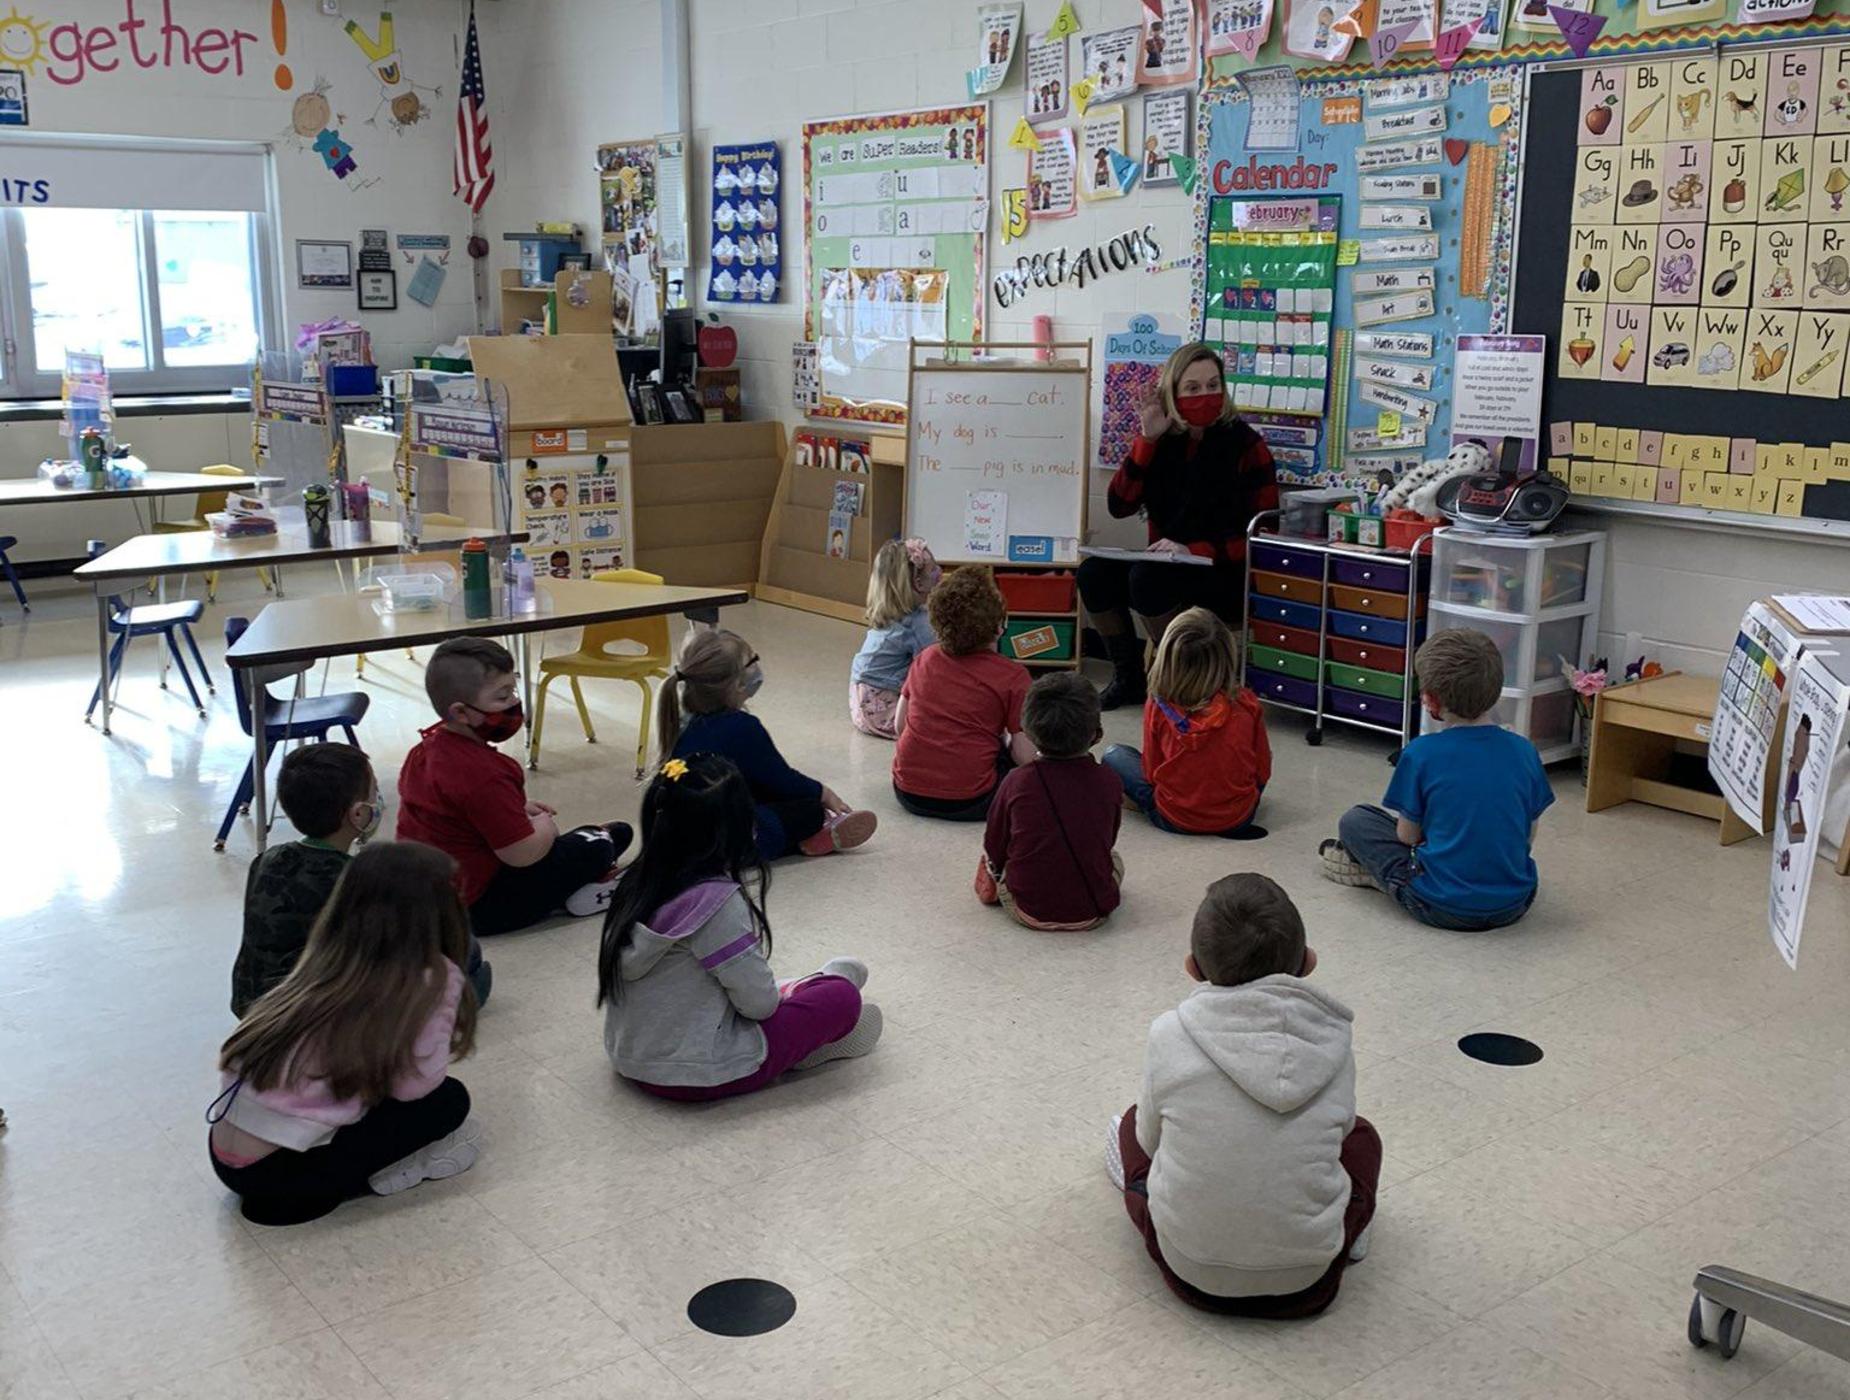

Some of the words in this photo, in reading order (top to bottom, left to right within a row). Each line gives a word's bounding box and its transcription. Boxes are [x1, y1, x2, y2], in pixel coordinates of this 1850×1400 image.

[1057, 14, 1069, 32] 5
[1564, 13, 1591, 36] 12
[1245, 29, 1255, 52] 8
[1378, 33, 1397, 60] 10
[1443, 32, 1462, 56] 11
[1591, 71, 1616, 92] Aa
[1637, 67, 1659, 89] Bb
[1682, 61, 1706, 85] Cc
[1730, 57, 1756, 81] Dd
[1783, 53, 1807, 77] Ee
[1016, 126, 1026, 144] 1
[1584, 150, 1612, 182] Gg
[1630, 149, 1655, 171] Hh
[1678, 145, 1698, 169] Ii
[1727, 144, 1746, 178] Jj
[1774, 142, 1800, 166] Kk
[1830, 139, 1850, 164] Ll
[1211, 154, 1339, 195] Calendar
[818, 180, 824, 201] i
[896, 176, 909, 193] u
[898, 211, 910, 229] a
[852, 244, 862, 261] e
[1575, 229, 1608, 251] Mm
[1622, 229, 1648, 251] Nn
[1666, 228, 1696, 250] Oo
[1720, 230, 1742, 262] Pp
[1768, 231, 1794, 249] Qu
[1822, 228, 1846, 252] Rr
[1771, 248, 1789, 267] qu
[1376, 273, 1400, 287] Math
[1382, 302, 1396, 316] Art
[1133, 322, 1154, 335] 100
[1574, 306, 1593, 329] Tt
[1616, 309, 1639, 331] Uu
[1663, 311, 1686, 333] Vv
[1705, 312, 1739, 336] Ww
[1759, 313, 1785, 338] Xx
[1812, 316, 1835, 351] Yy
[1373, 336, 1395, 350] Math
[924, 388, 937, 406] I
[976, 393, 988, 406] a
[917, 421, 942, 446] My
[953, 423, 975, 446] dog
[984, 424, 999, 439] is
[1558, 433, 1567, 444] a
[1579, 432, 1589, 445] b
[1601, 438, 1610, 449] c
[1623, 438, 1632, 451] d
[1670, 443, 1678, 456] f
[1690, 446, 1700, 461] g
[1712, 446, 1722, 459] h
[1761, 455, 1769, 471] j
[1785, 453, 1795, 467] k
[1833, 455, 1849, 468] m
[917, 454, 942, 473] The
[983, 459, 1005, 479] pig
[1012, 460, 1024, 474] is
[1031, 461, 1044, 475] in
[1574, 475, 1587, 484] qu
[1599, 474, 1606, 484] r
[1619, 475, 1628, 486] s
[1643, 477, 1649, 488] t
[1664, 480, 1674, 490] u
[1688, 481, 1697, 492] v
[1710, 485, 1722, 496] w
[1734, 487, 1745, 497] x
[1757, 489, 1769, 503] y
[1786, 492, 1795, 504] z
[1015, 540, 1046, 554] easel
